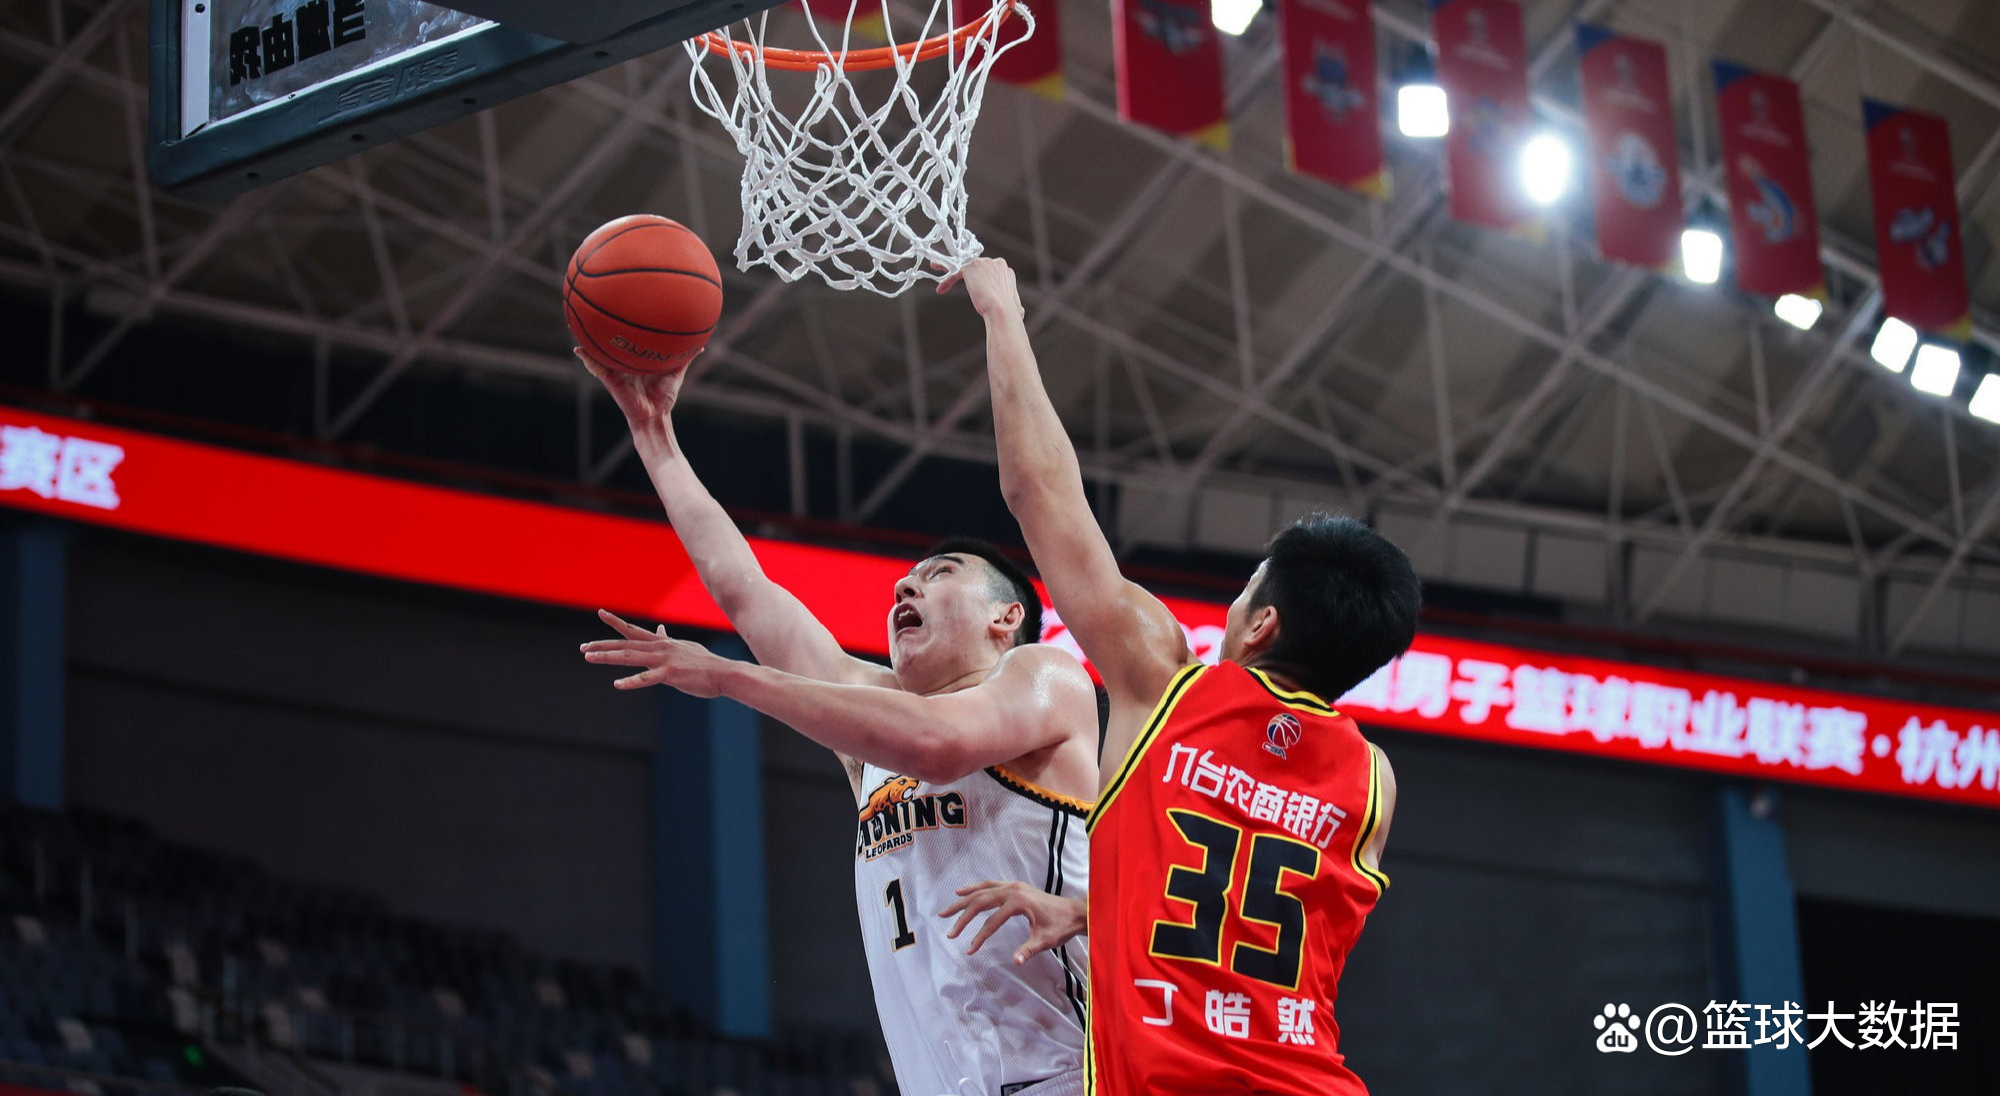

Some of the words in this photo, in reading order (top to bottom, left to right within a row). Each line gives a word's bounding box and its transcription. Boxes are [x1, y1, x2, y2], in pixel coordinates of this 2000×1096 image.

[1162, 742, 1347, 850] 九台农商银行
[865, 832, 913, 860] LEOPARDS
[883, 878, 916, 953] 1
[1149, 808, 1321, 992] 35
[1133, 978, 1316, 1046] 丁皓然
